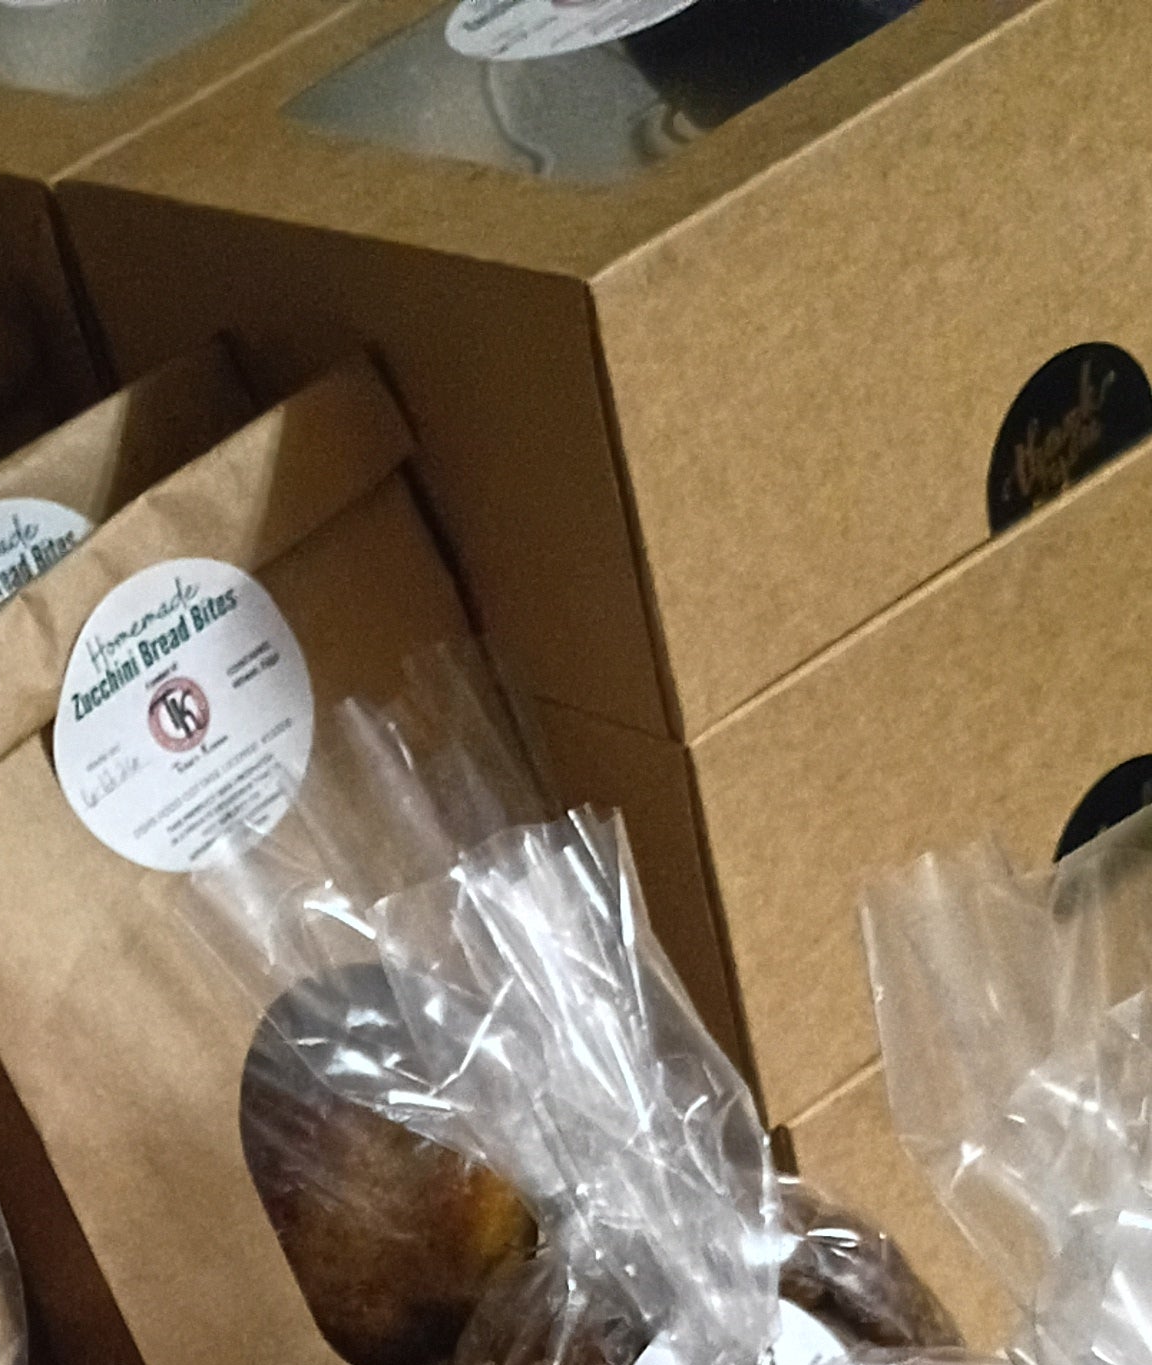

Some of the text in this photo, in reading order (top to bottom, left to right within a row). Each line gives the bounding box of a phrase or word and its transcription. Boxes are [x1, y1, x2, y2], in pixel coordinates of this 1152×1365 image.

[71, 654, 140, 722] Zucchini
[140, 616, 191, 670] Bread
[193, 586, 239, 632] Bites
[86, 576, 200, 671] Homemade
